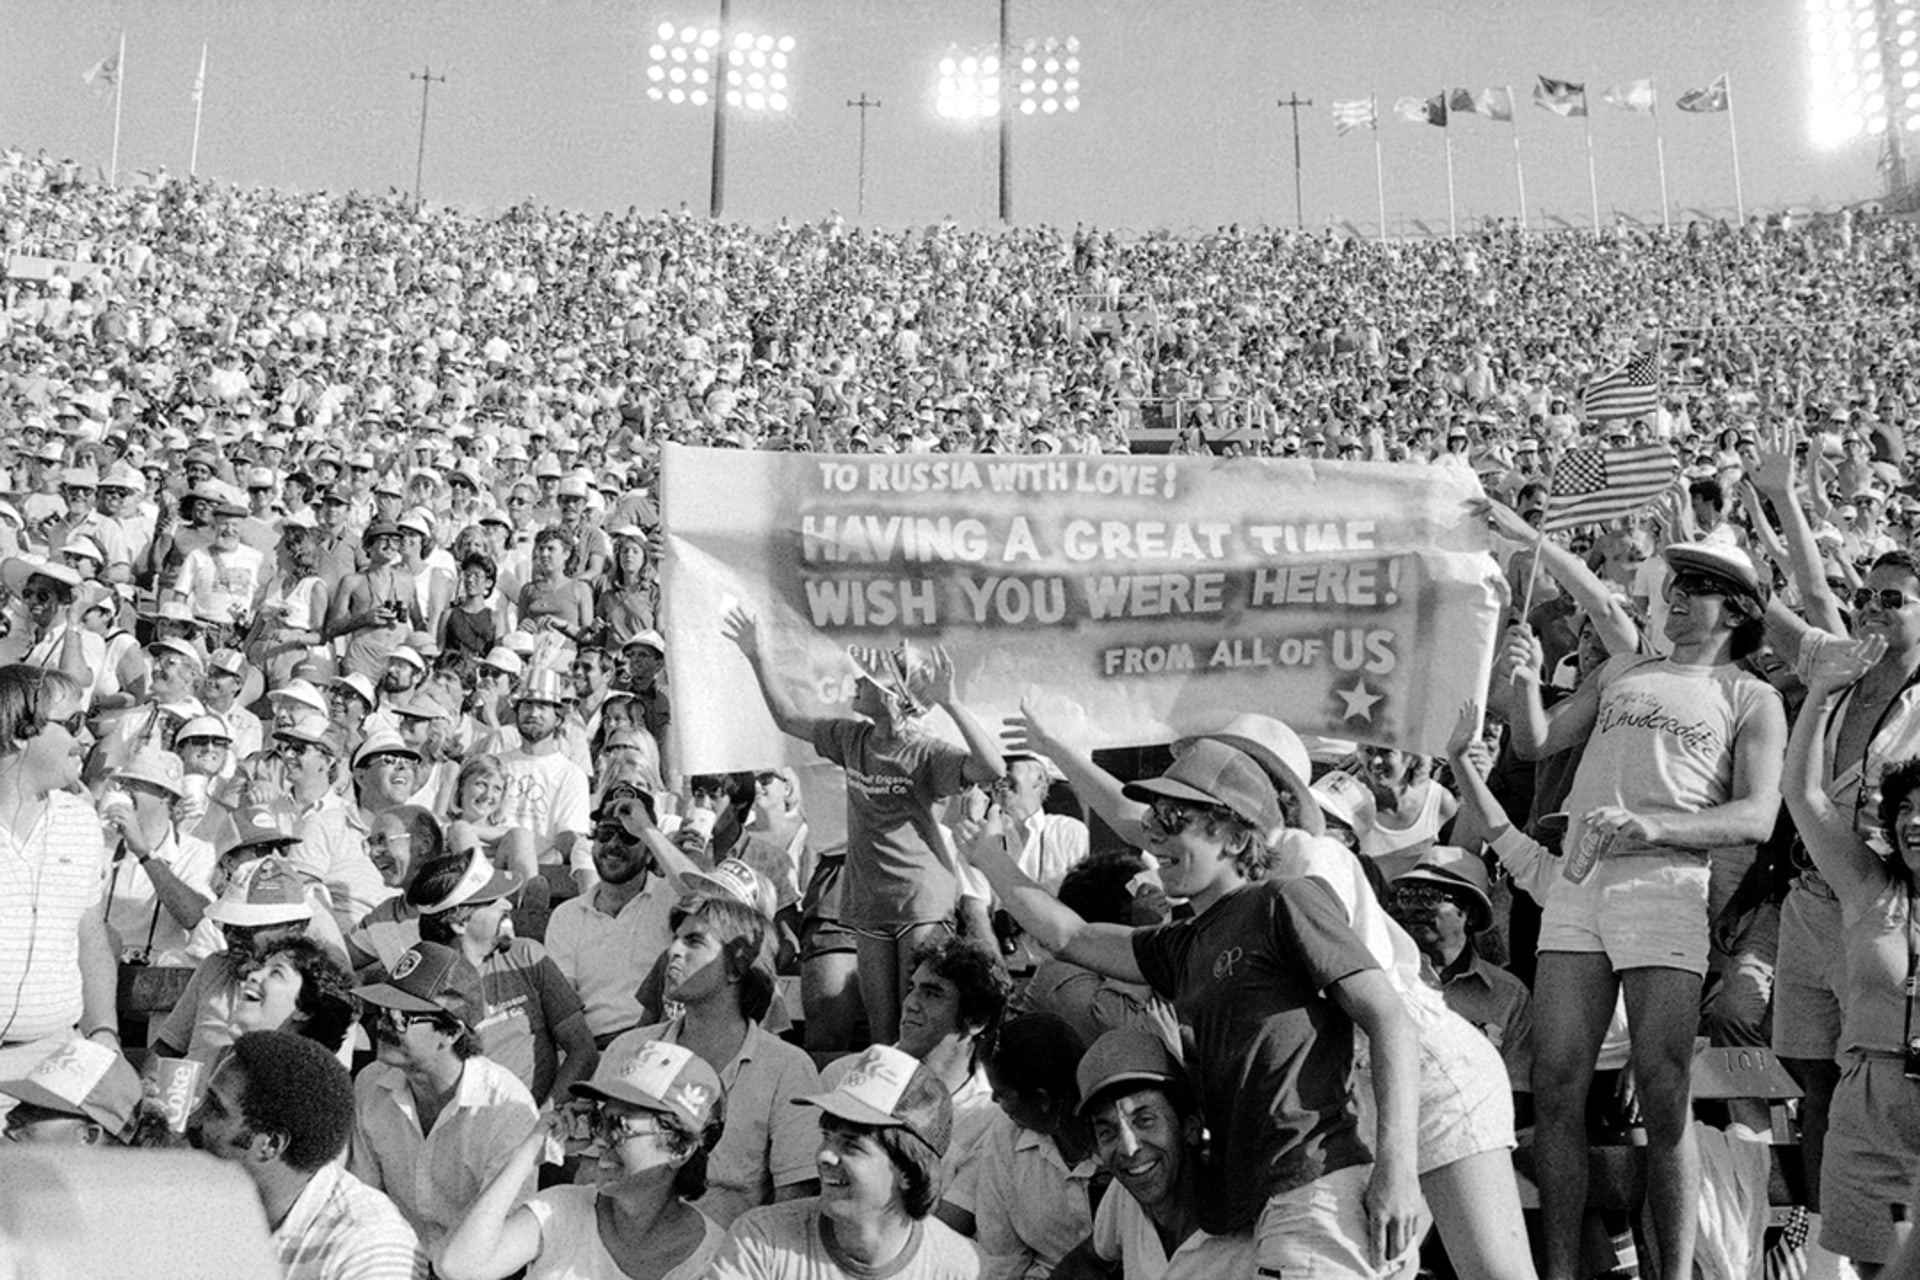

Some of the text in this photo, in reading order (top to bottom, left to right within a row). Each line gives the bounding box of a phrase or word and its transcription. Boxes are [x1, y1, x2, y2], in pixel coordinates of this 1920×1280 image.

[819, 462, 858, 490] TO
[868, 462, 982, 491] RUSSIA
[988, 463, 1068, 491] WITH
[802, 515, 1376, 562] HAVING A GREAT TIME
[805, 579, 937, 627] WISH
[961, 576, 1067, 624] YOU
[1085, 572, 1227, 620] WERE
[1105, 629, 1397, 676] FROM ALL OF US
